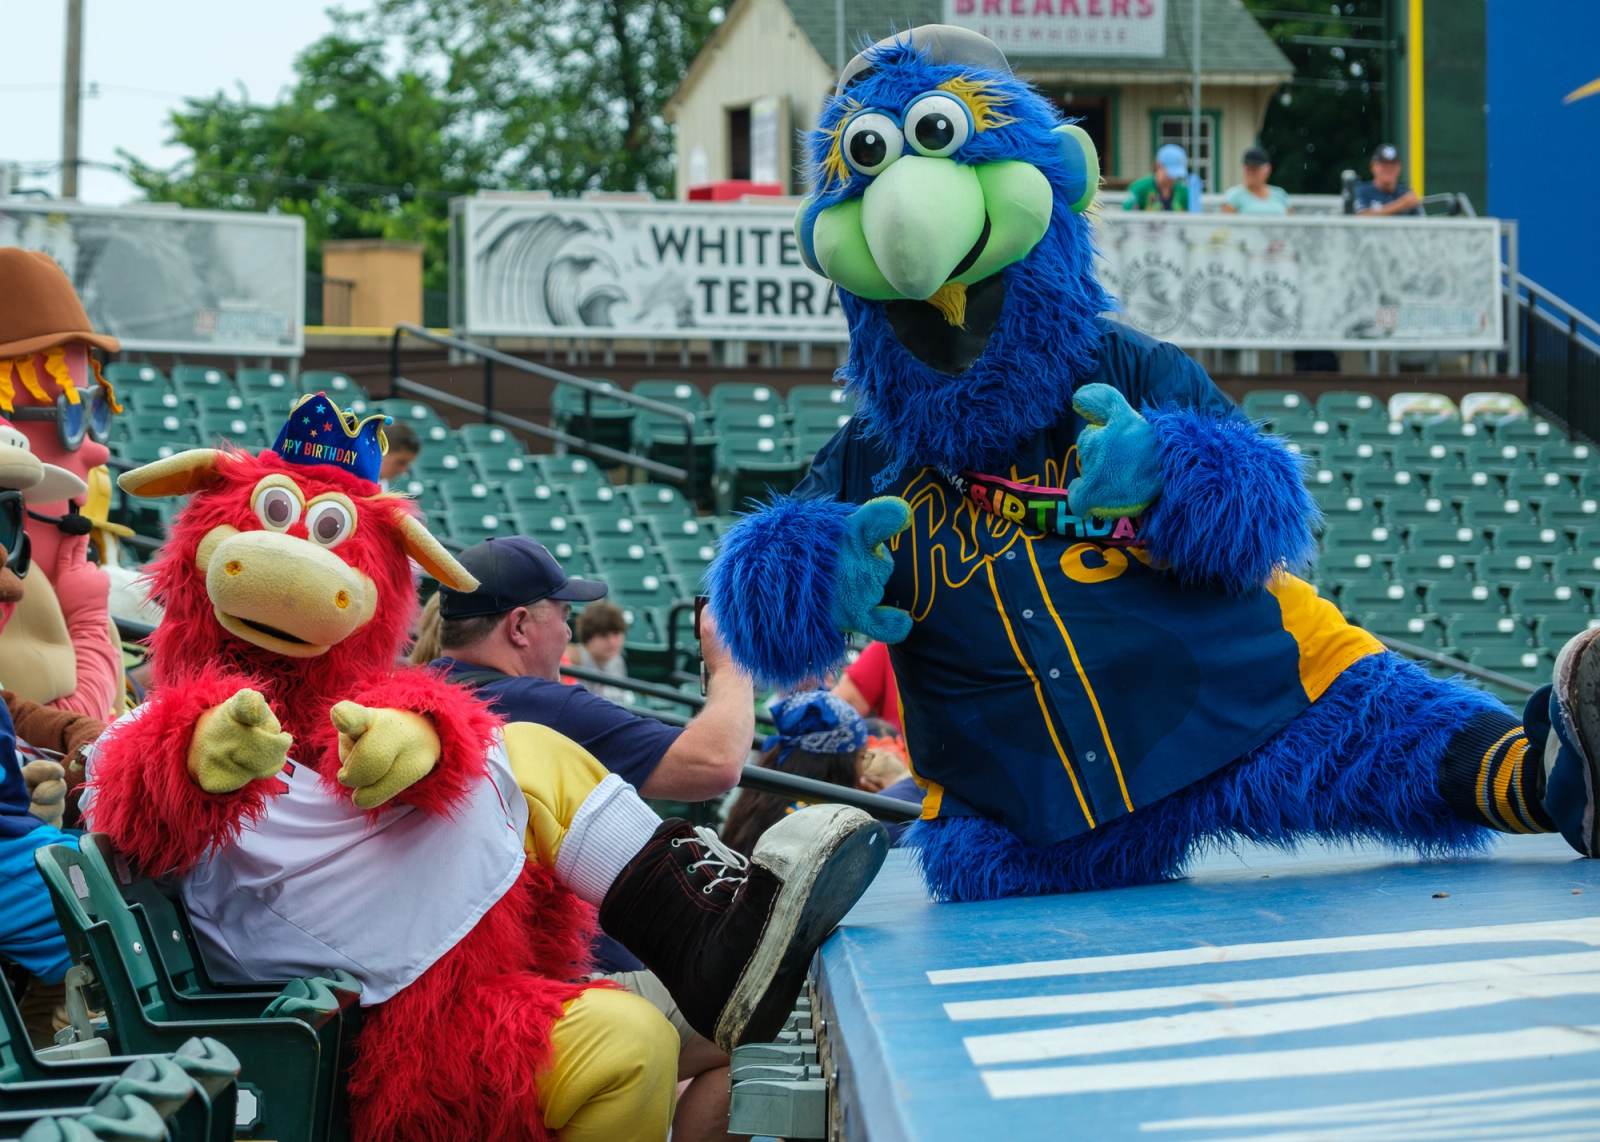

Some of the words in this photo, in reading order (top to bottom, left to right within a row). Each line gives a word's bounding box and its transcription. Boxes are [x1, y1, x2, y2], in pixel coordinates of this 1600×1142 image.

[954, 0, 1155, 18] BREAKERS
[650, 226, 800, 267] WHITE
[304, 441, 358, 466] BIRTHDAY
[969, 483, 1138, 539] BIRTHDA
